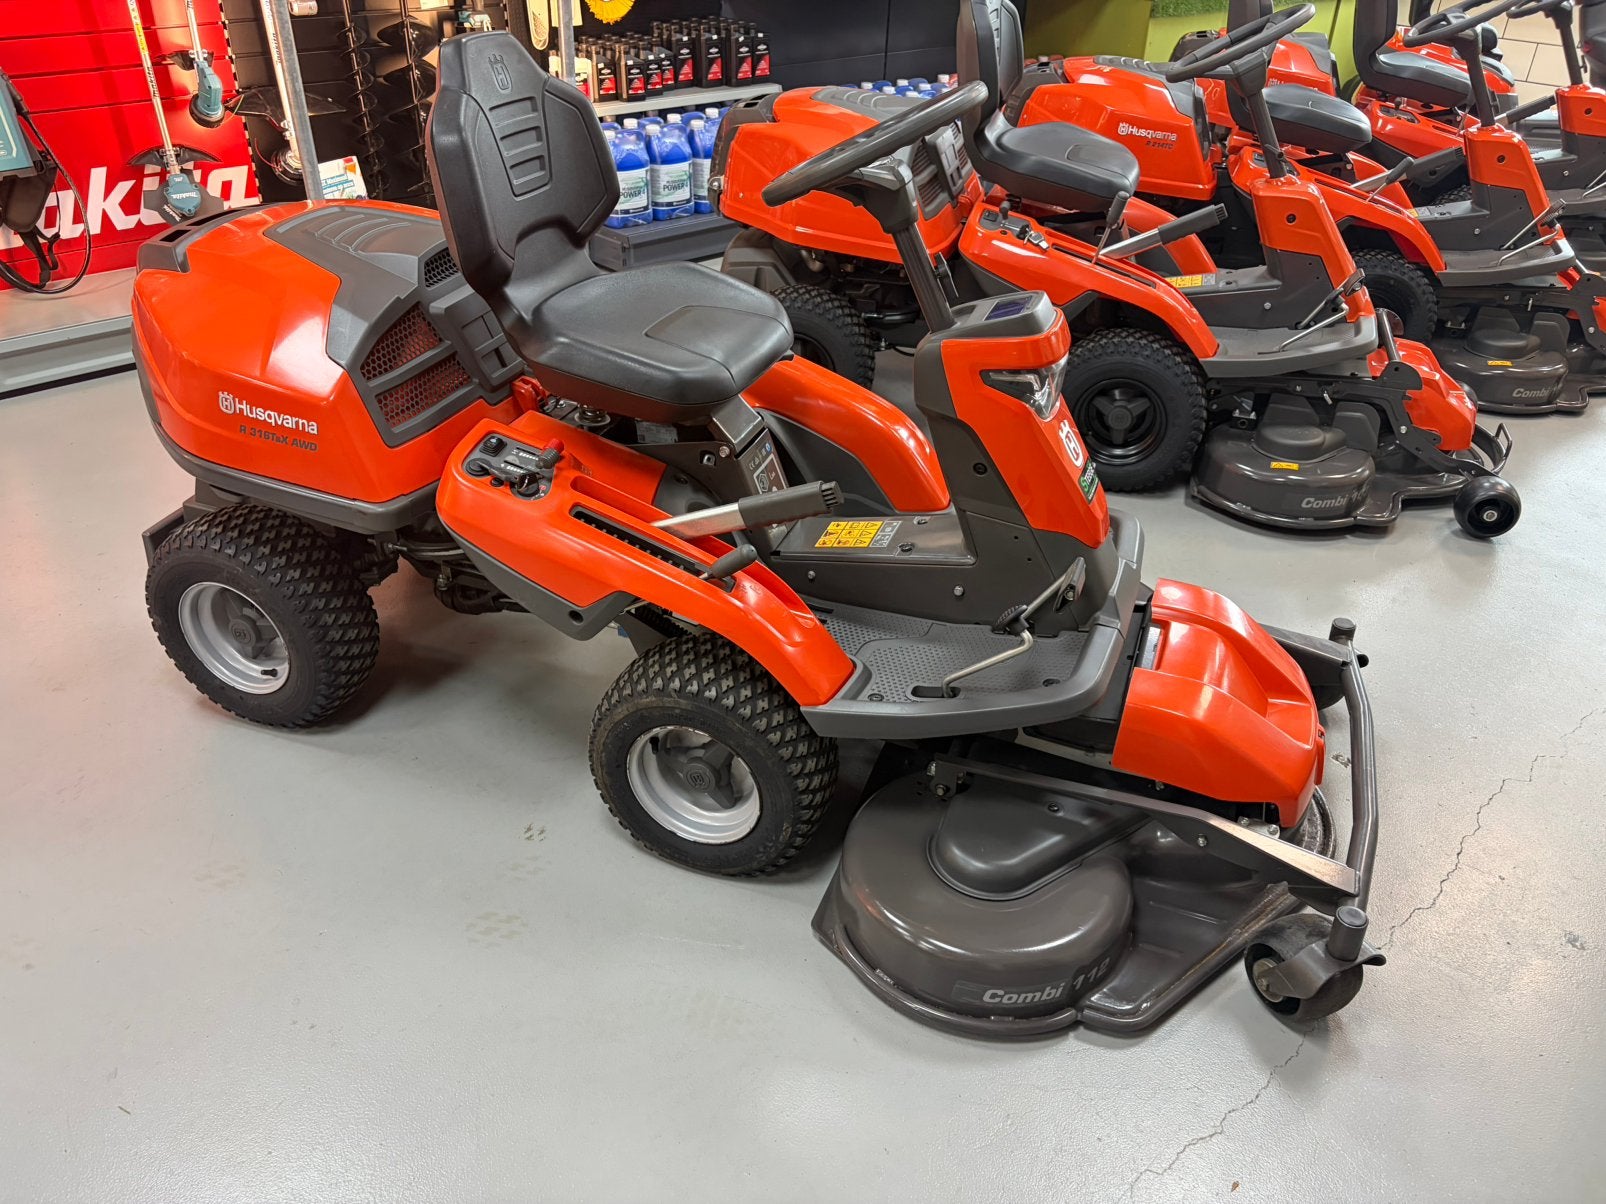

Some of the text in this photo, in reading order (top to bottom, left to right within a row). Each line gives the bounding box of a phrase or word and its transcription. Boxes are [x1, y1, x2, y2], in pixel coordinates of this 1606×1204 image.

[1128, 125, 1177, 141] Husqvarna
[663, 183, 684, 192] POWER
[1512, 387, 1550, 398] Combi
[235, 398, 318, 435] Husqvarna
[239, 425, 247, 434] R
[291, 438, 318, 452] AWD
[1301, 494, 1349, 508] Combi
[982, 957, 1110, 1004] Combi 112
